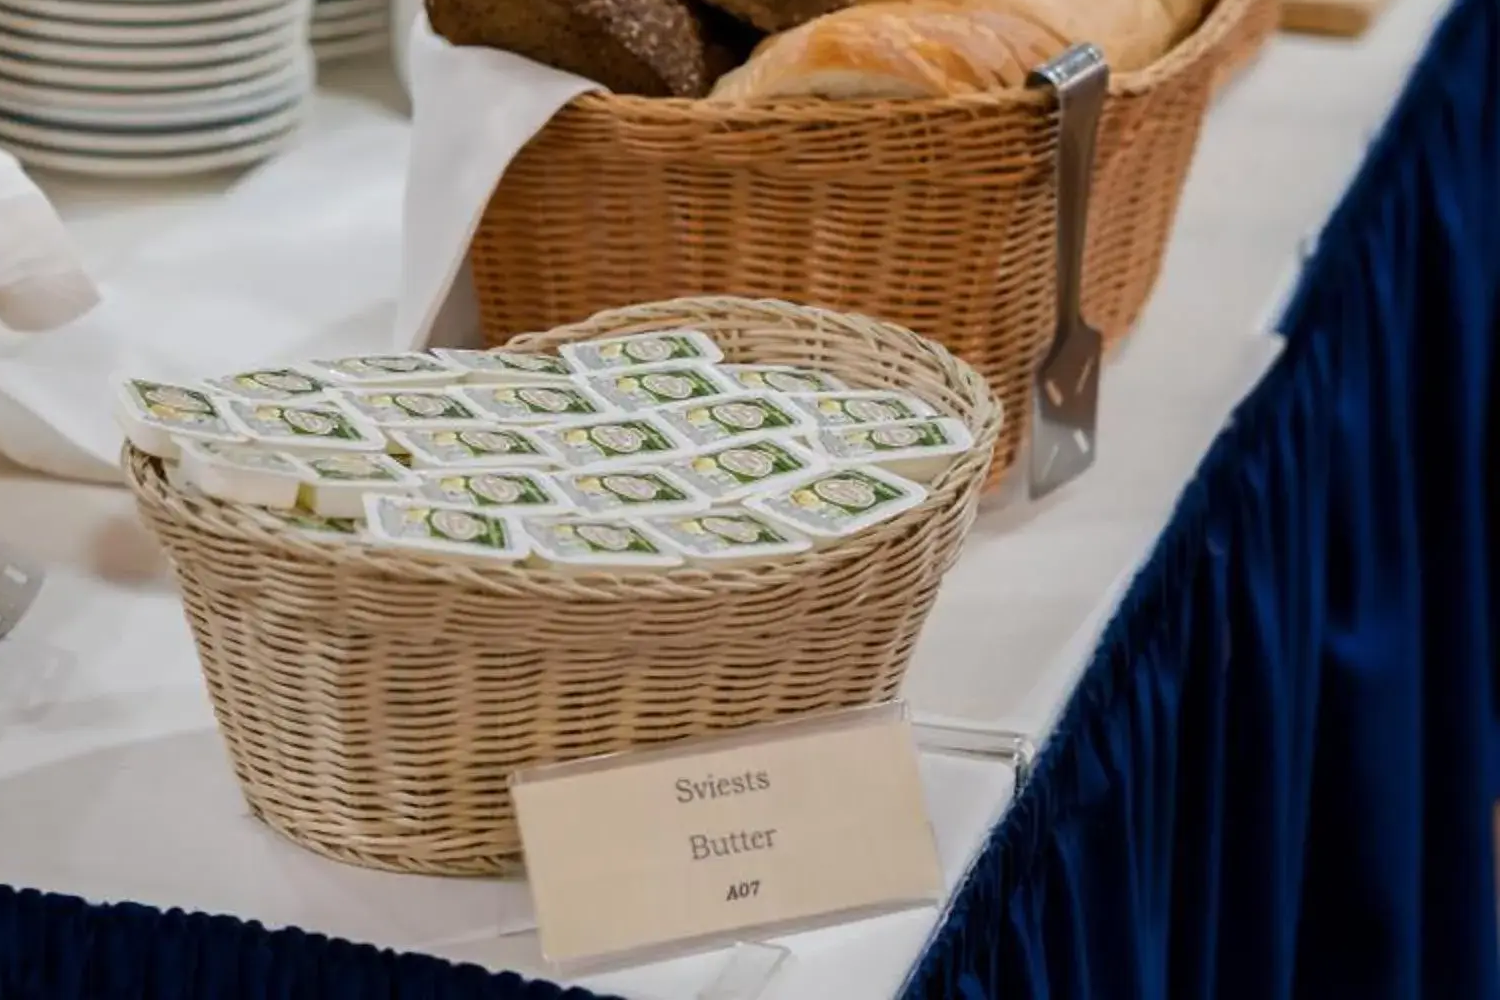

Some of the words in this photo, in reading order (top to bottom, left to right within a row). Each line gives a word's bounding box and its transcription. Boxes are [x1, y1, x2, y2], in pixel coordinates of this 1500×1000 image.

[674, 769, 771, 803] Sviests
[689, 828, 778, 860] Butter
[725, 880, 761, 901] A07
